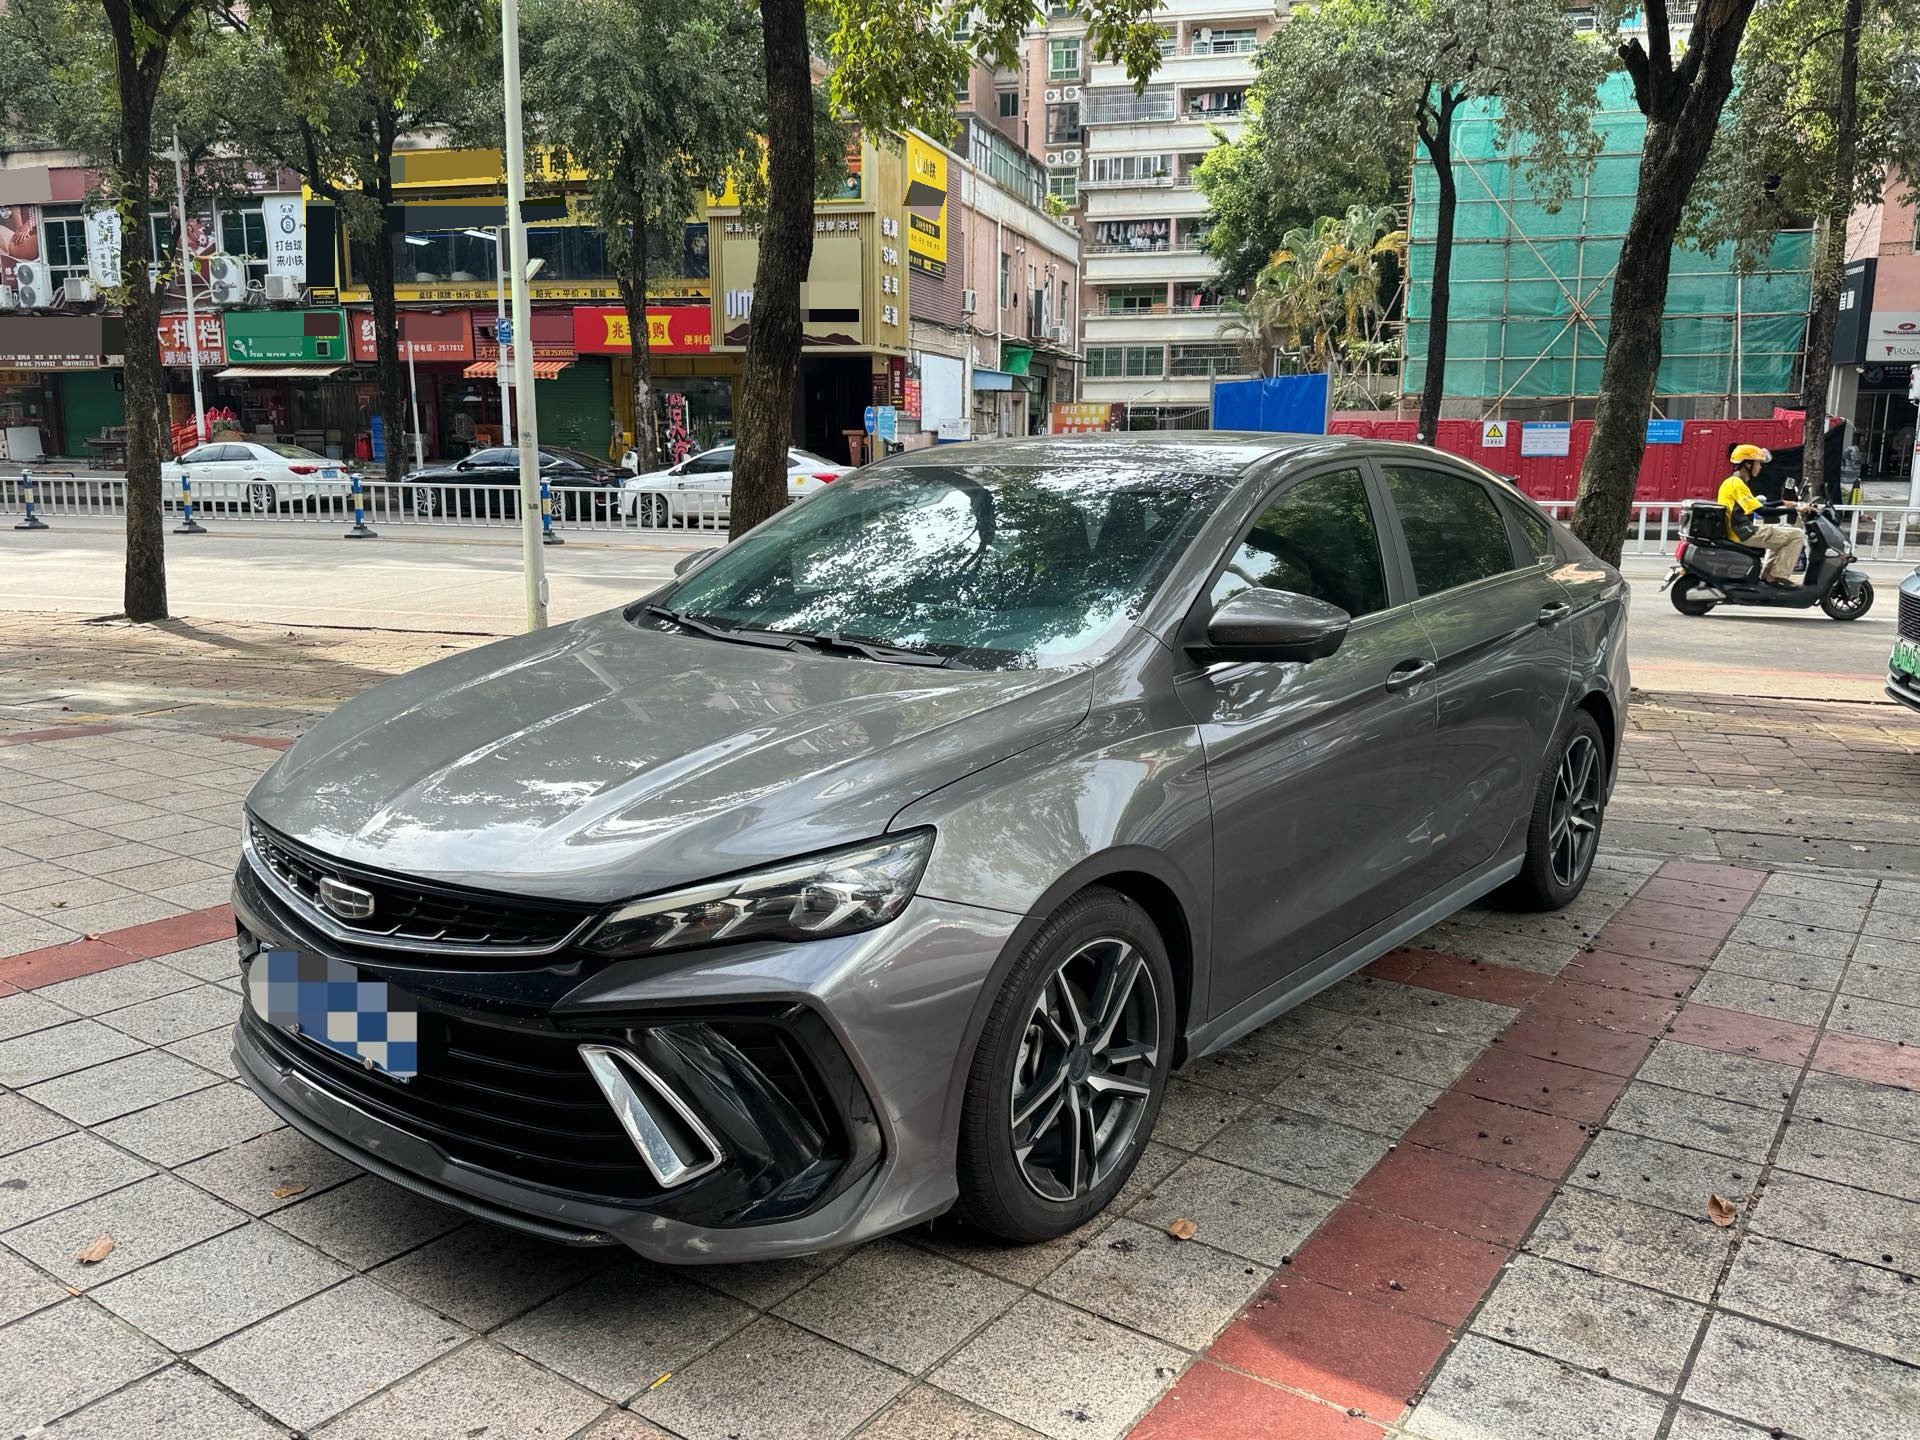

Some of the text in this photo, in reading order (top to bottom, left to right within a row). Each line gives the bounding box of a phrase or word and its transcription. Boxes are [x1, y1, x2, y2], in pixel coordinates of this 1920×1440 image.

[725, 223, 744, 233] 采耳
[816, 220, 835, 232] 按摩
[838, 220, 859, 231] 茶饮
[275, 241, 302, 251] 打台球
[276, 256, 304, 266] 来小铁
[882, 246, 898, 267] SPA
[684, 335, 711, 345] 便利店
